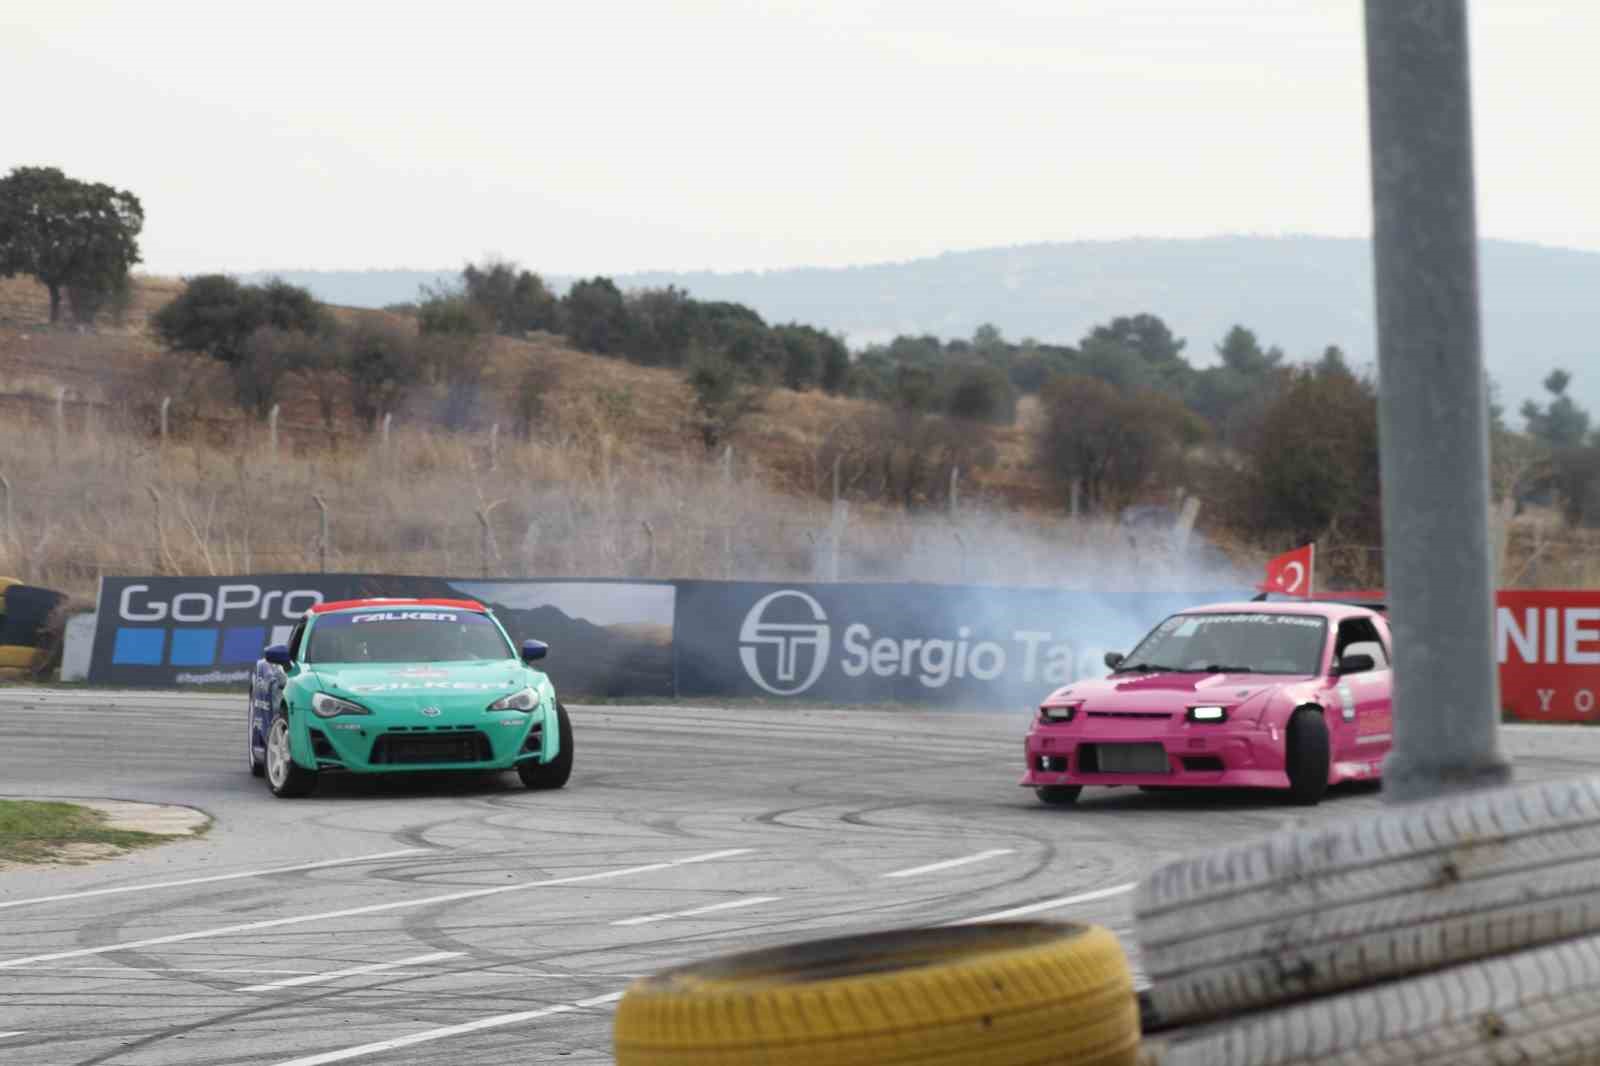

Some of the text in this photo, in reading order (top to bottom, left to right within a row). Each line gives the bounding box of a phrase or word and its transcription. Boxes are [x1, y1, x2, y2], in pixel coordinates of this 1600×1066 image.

[119, 584, 324, 622] GoPro
[351, 611, 457, 623] FALKEN
[841, 622, 1006, 688] Sergio
